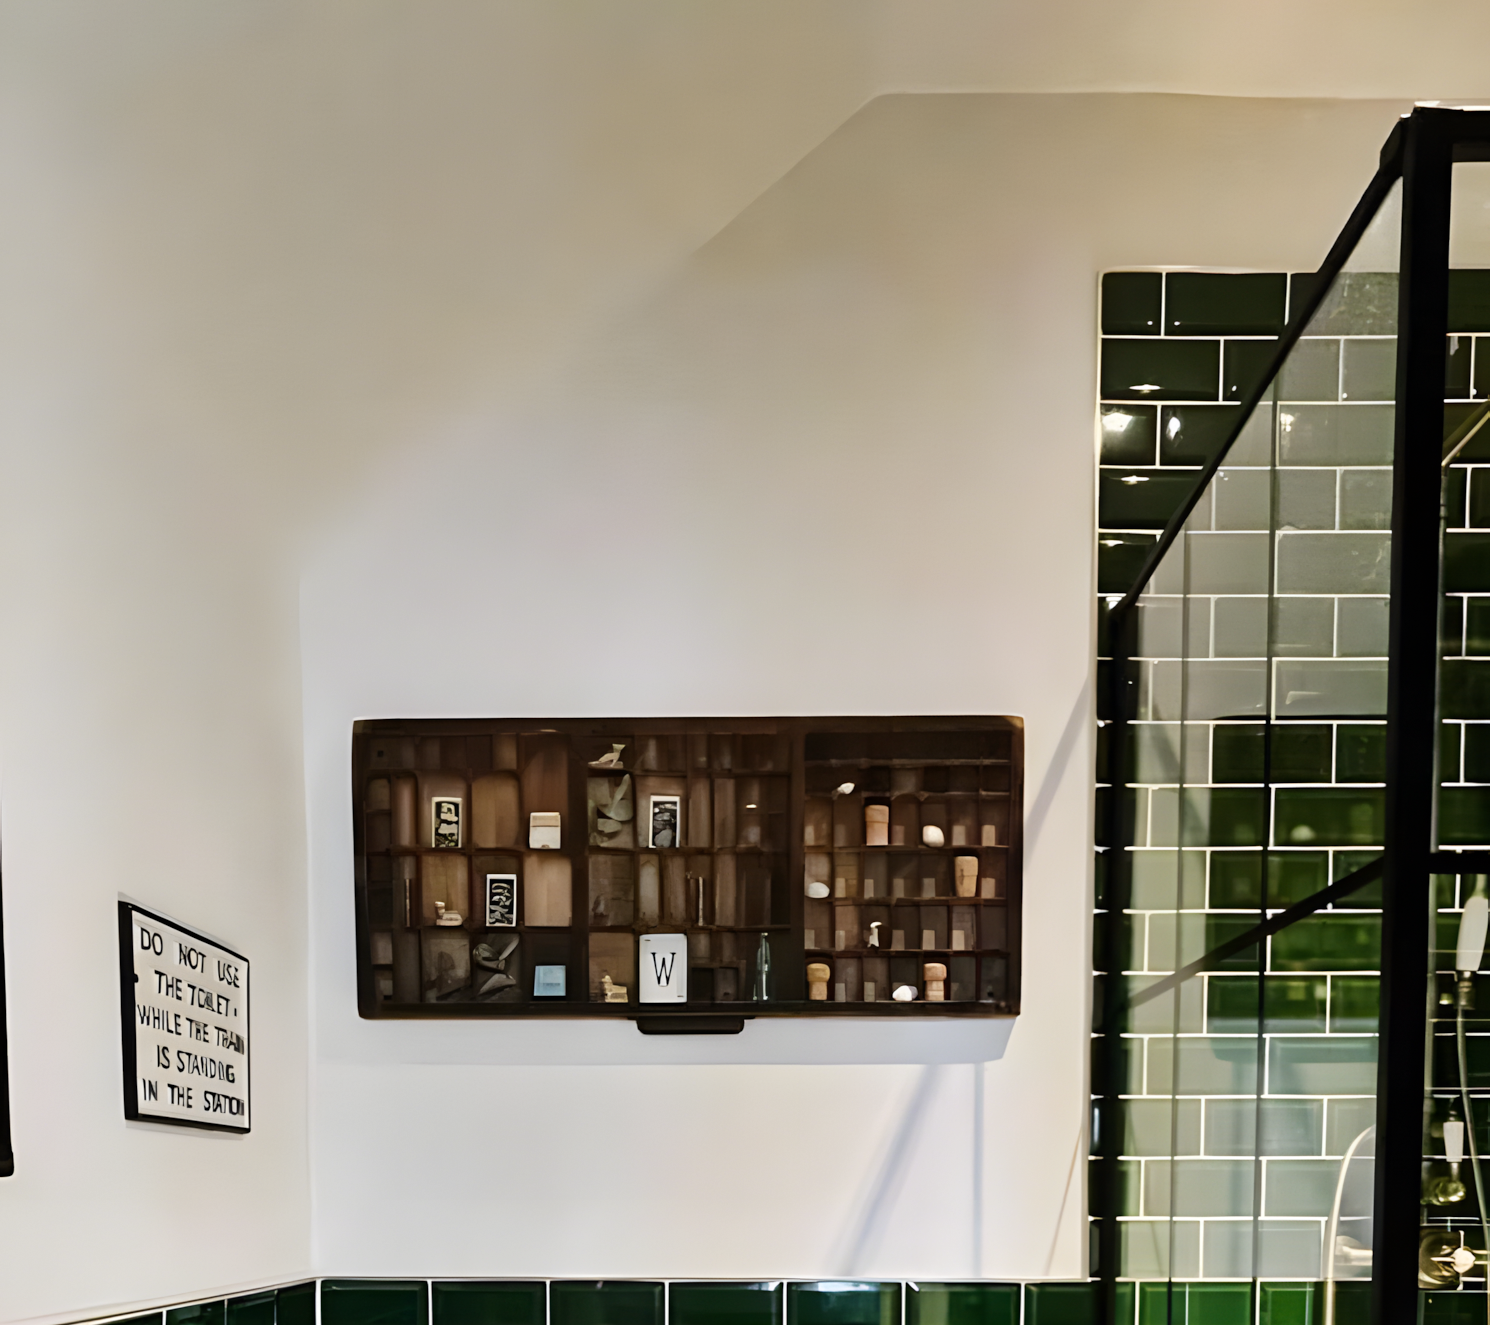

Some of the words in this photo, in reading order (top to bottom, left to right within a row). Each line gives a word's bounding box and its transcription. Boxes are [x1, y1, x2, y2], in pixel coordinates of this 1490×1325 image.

[141, 927, 163, 956] DO
[178, 943, 207, 973] NOT
[217, 960, 240, 988] USE
[650, 952, 676, 987] W
[154, 970, 182, 1001] THE
[187, 983, 231, 1017] TOLET
[137, 1004, 182, 1036] WHILE
[214, 1026, 245, 1055] TRAI
[157, 1045, 171, 1069] IS
[176, 1050, 236, 1083] STANDNG
[142, 1078, 158, 1101] IN
[167, 1083, 193, 1109] THE
[204, 1090, 245, 1116] STATO
